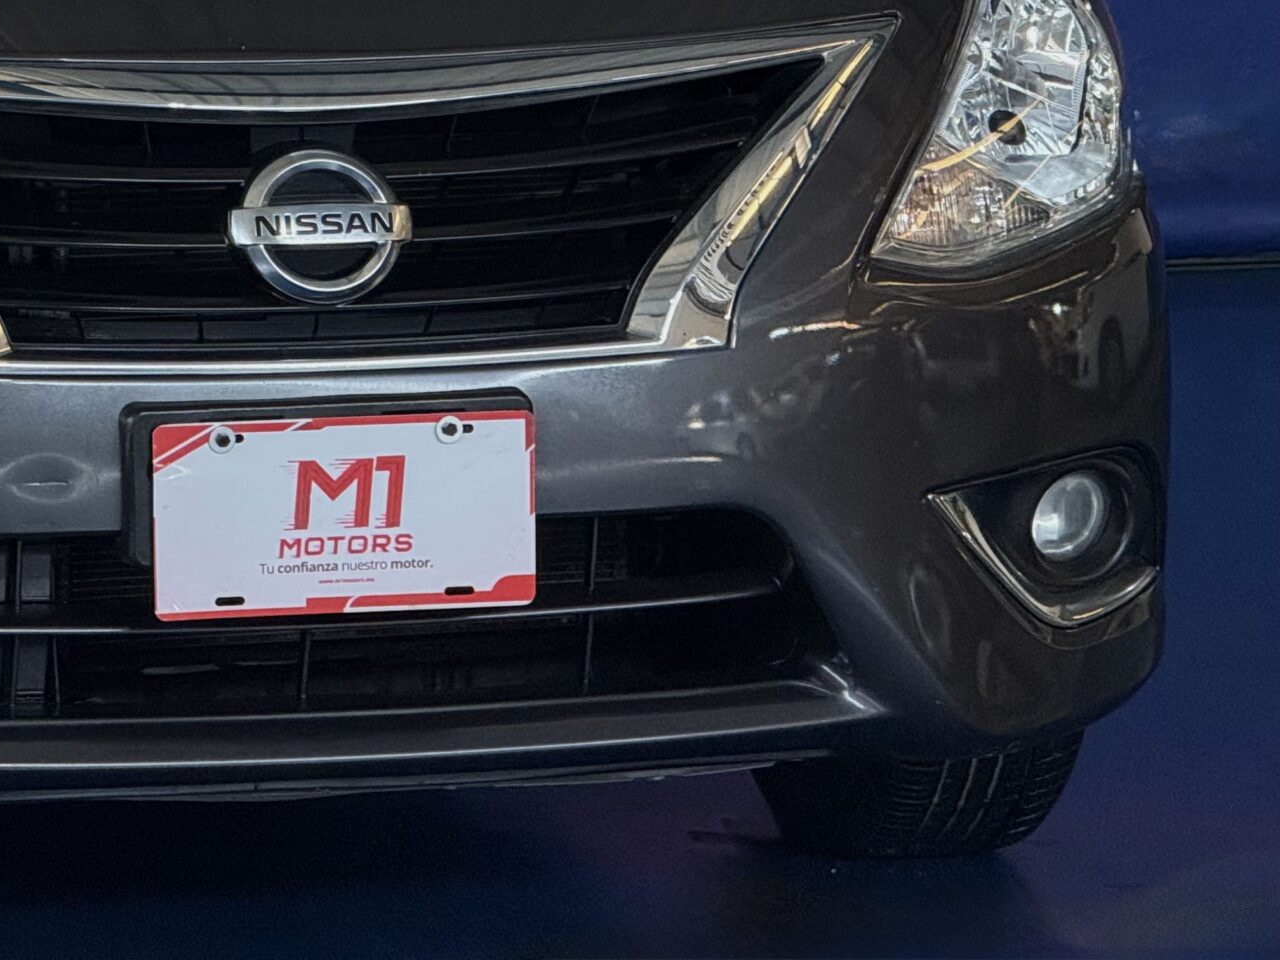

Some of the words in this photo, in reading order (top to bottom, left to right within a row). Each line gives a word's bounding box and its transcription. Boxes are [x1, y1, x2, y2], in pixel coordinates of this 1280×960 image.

[255, 211, 394, 238] NISSAN
[282, 454, 407, 531] M1
[278, 533, 414, 559] MOTORS
[259, 563, 275, 575] Tu
[278, 561, 339, 574] confianza
[342, 560, 388, 572] nuestro
[391, 558, 434, 570] motor.
